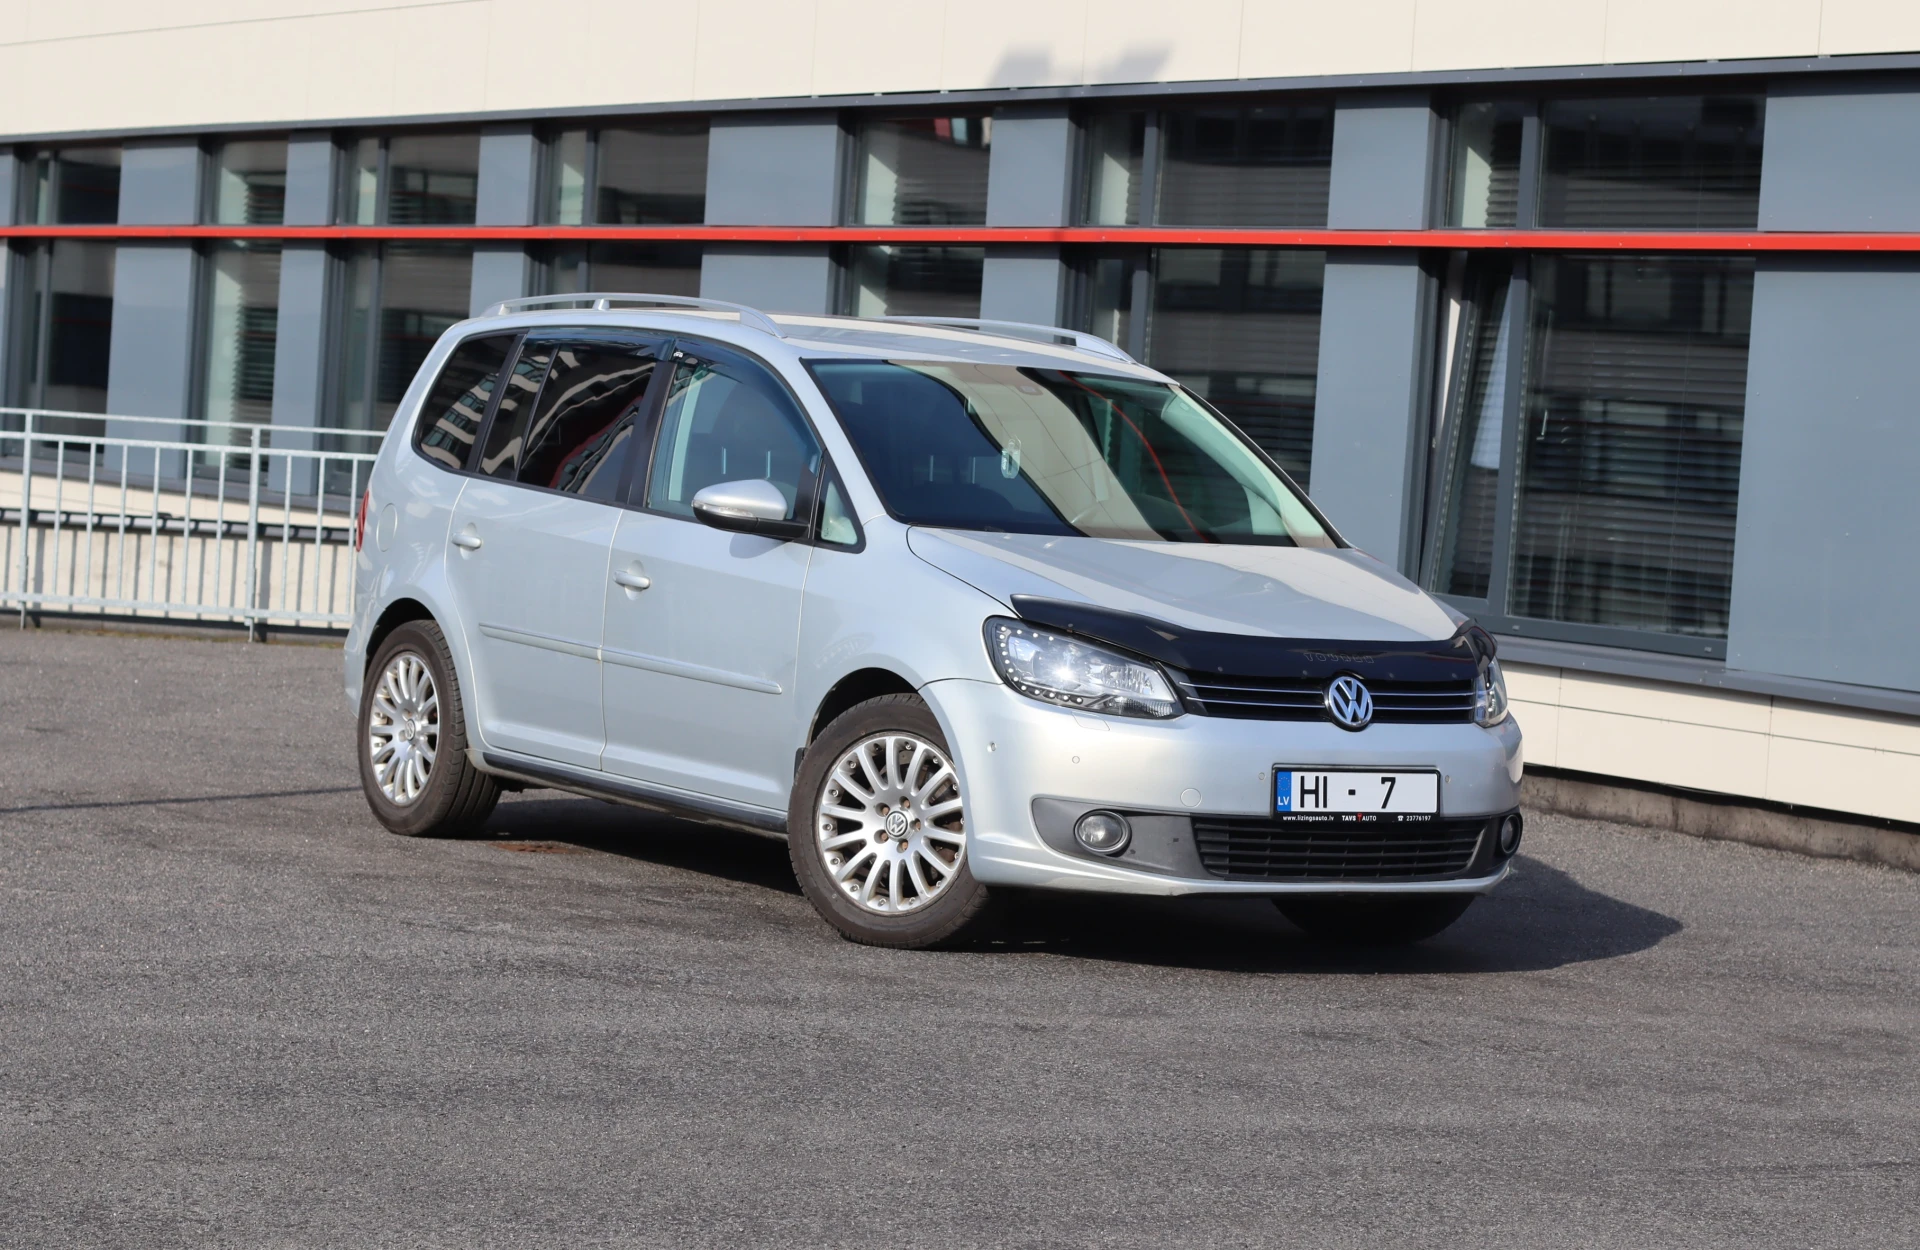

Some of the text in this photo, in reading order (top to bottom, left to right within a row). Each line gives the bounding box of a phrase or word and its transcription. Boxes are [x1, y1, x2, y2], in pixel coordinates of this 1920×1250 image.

[1328, 675, 1373, 727] VW
[1277, 796, 1290, 806] LV
[1300, 775, 1328, 809] HI
[1381, 776, 1396, 809] 7
[1282, 814, 1335, 823] www.lizingsauto.lv
